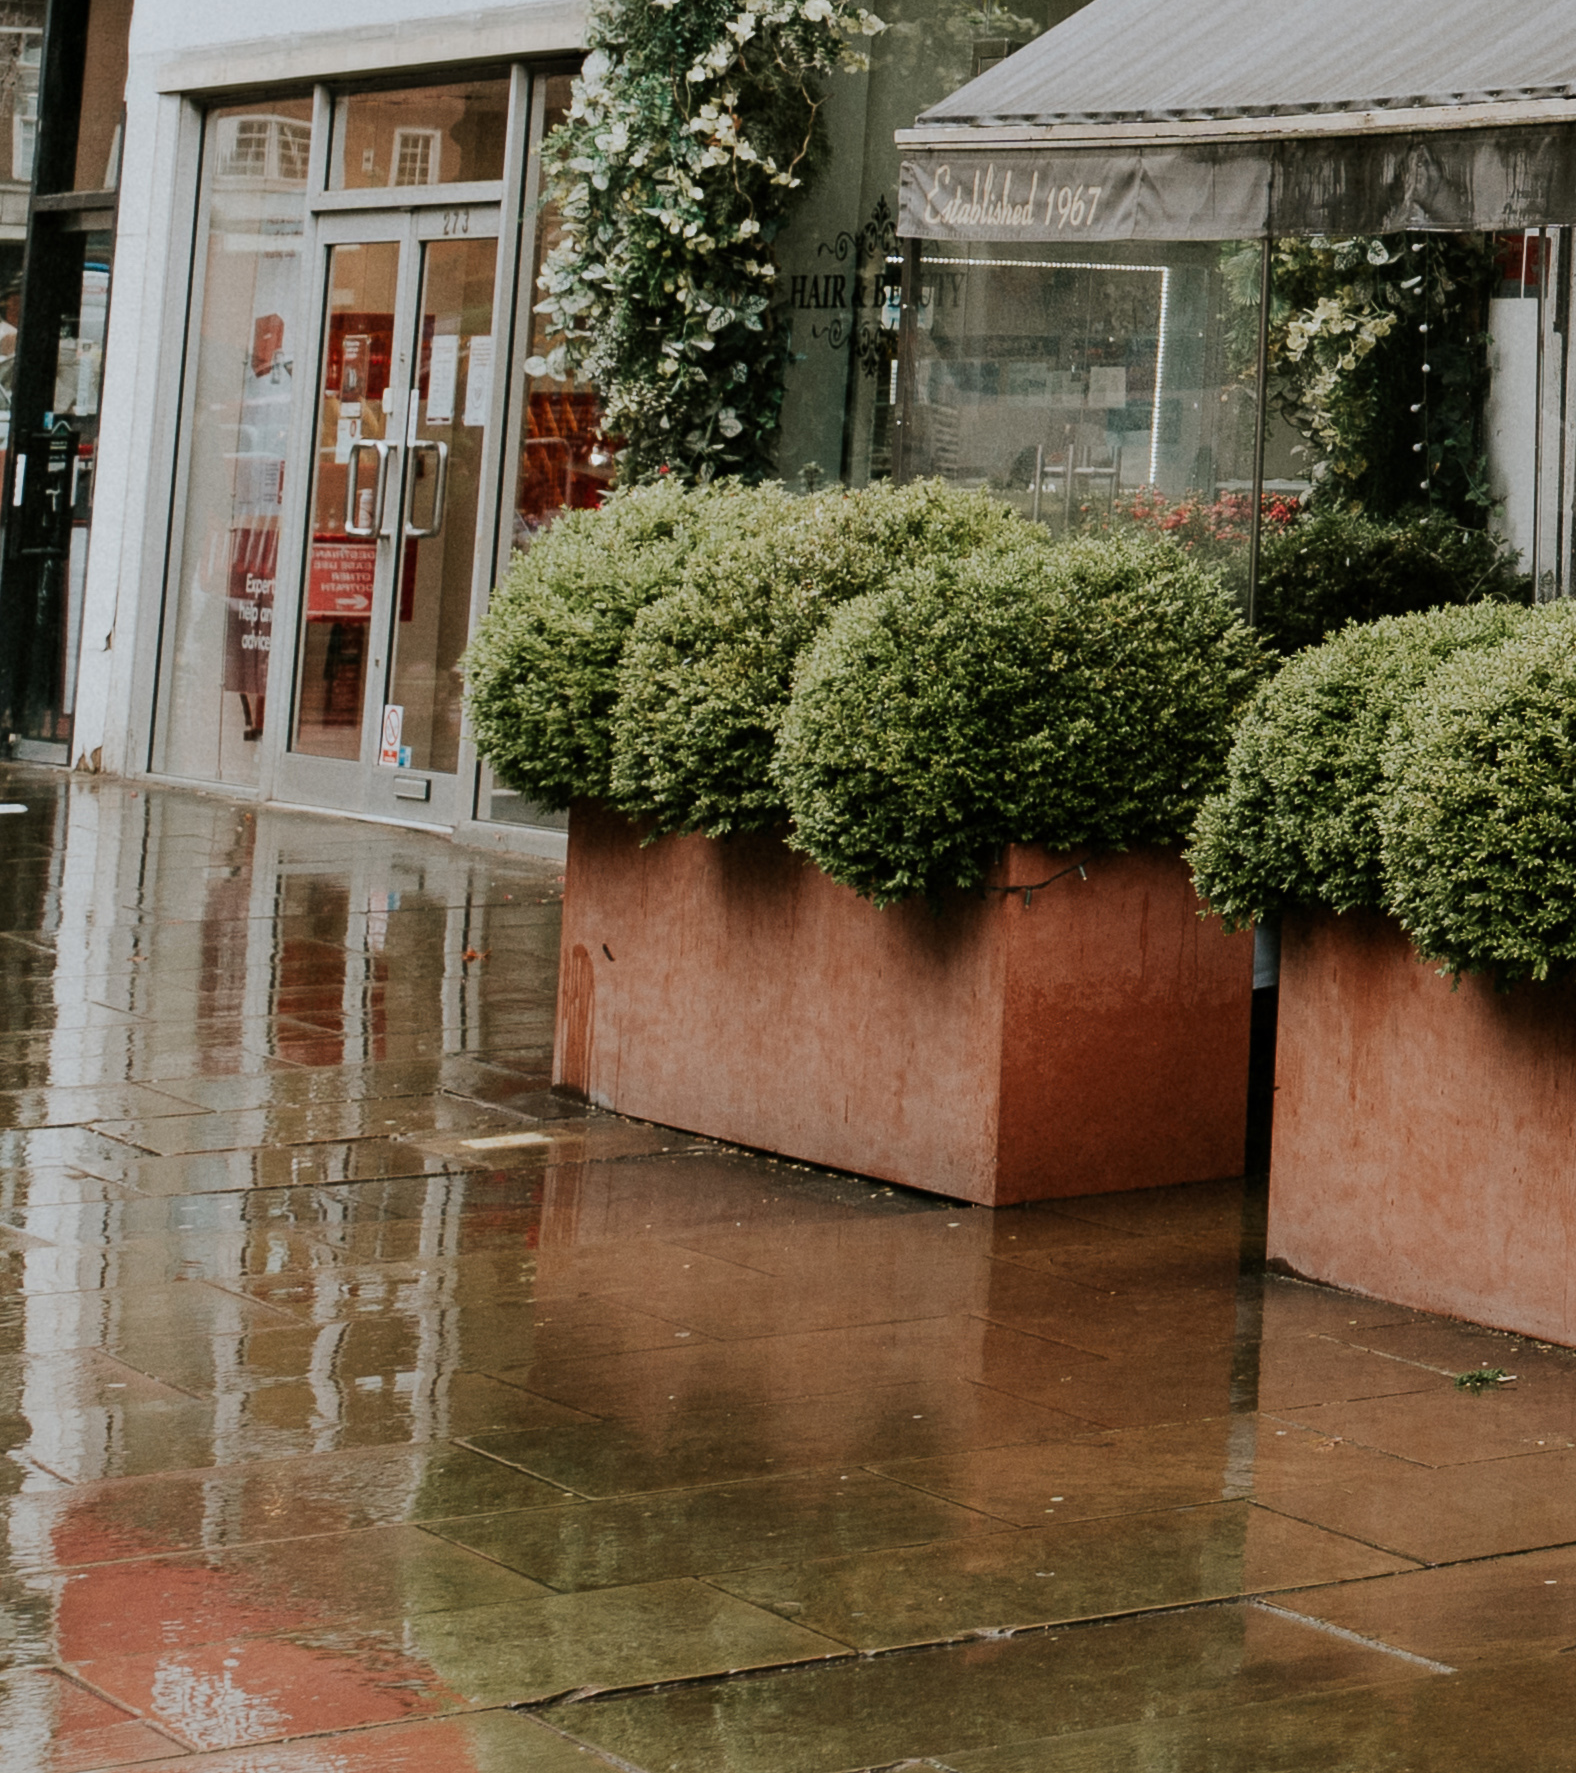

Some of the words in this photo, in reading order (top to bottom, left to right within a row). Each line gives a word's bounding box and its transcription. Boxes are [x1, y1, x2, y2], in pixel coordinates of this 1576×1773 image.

[924, 162, 1038, 226] Established
[1044, 185, 1101, 229] 1967
[443, 211, 471, 235] 273
[790, 272, 847, 310] HAIR
[874, 271, 968, 308] BEUTY
[246, 573, 276, 599] Expert
[239, 601, 258, 627] help
[241, 629, 271, 651] advice
